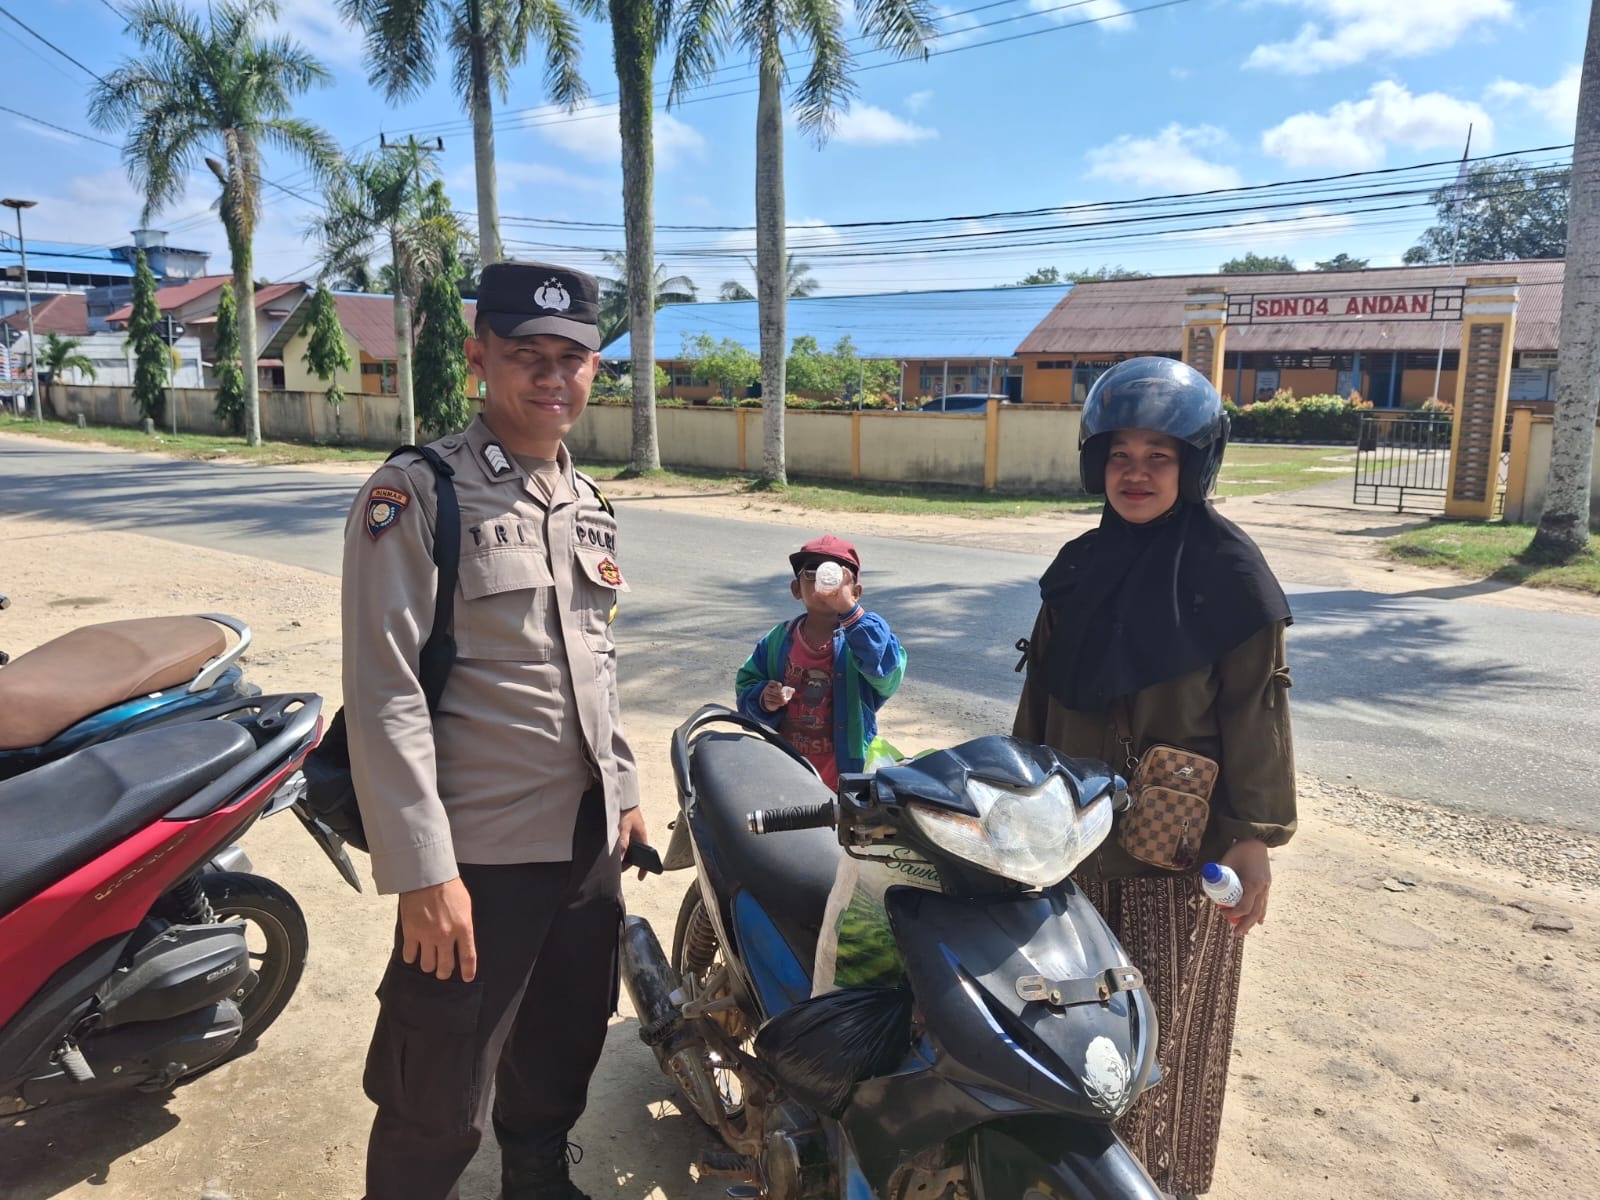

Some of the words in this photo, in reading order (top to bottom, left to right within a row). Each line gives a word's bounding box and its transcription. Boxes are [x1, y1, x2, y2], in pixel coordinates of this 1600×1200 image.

[1344, 294, 1428, 315] ANDAN
[469, 524, 526, 546] TRI
[575, 525, 616, 551] POLRI
